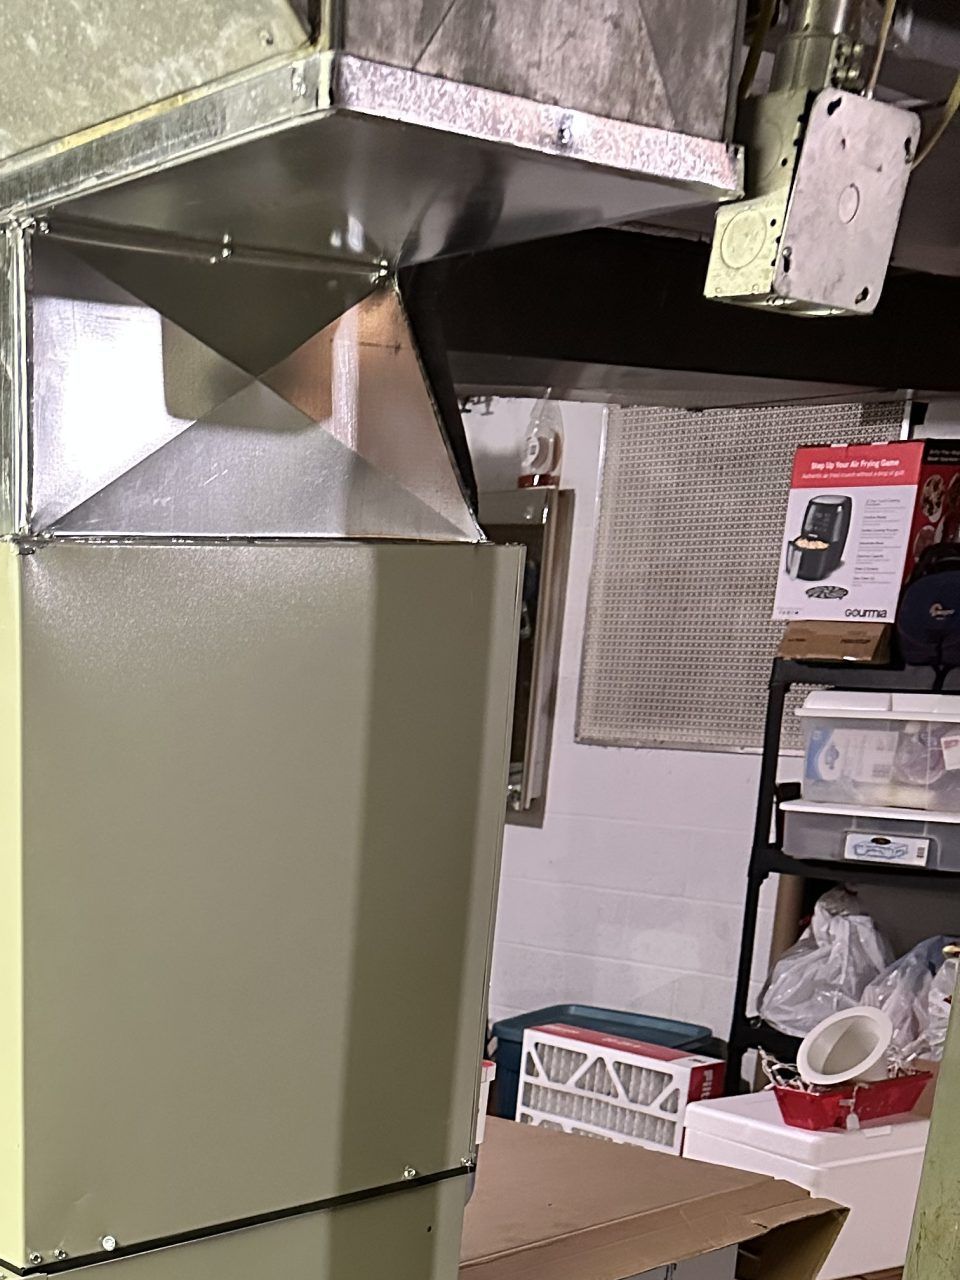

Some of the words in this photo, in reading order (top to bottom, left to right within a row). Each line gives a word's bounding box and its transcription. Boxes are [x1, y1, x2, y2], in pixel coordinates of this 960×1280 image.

[810, 462, 825, 471] Step
[825, 461, 835, 470] Up
[836, 461, 850, 469] Your
[850, 460, 860, 468] Air
[860, 459, 880, 469] Frying
[880, 458, 900, 467] Game
[844, 608, 888, 619] Gourmia
[701, 1069, 714, 1099] Filt
